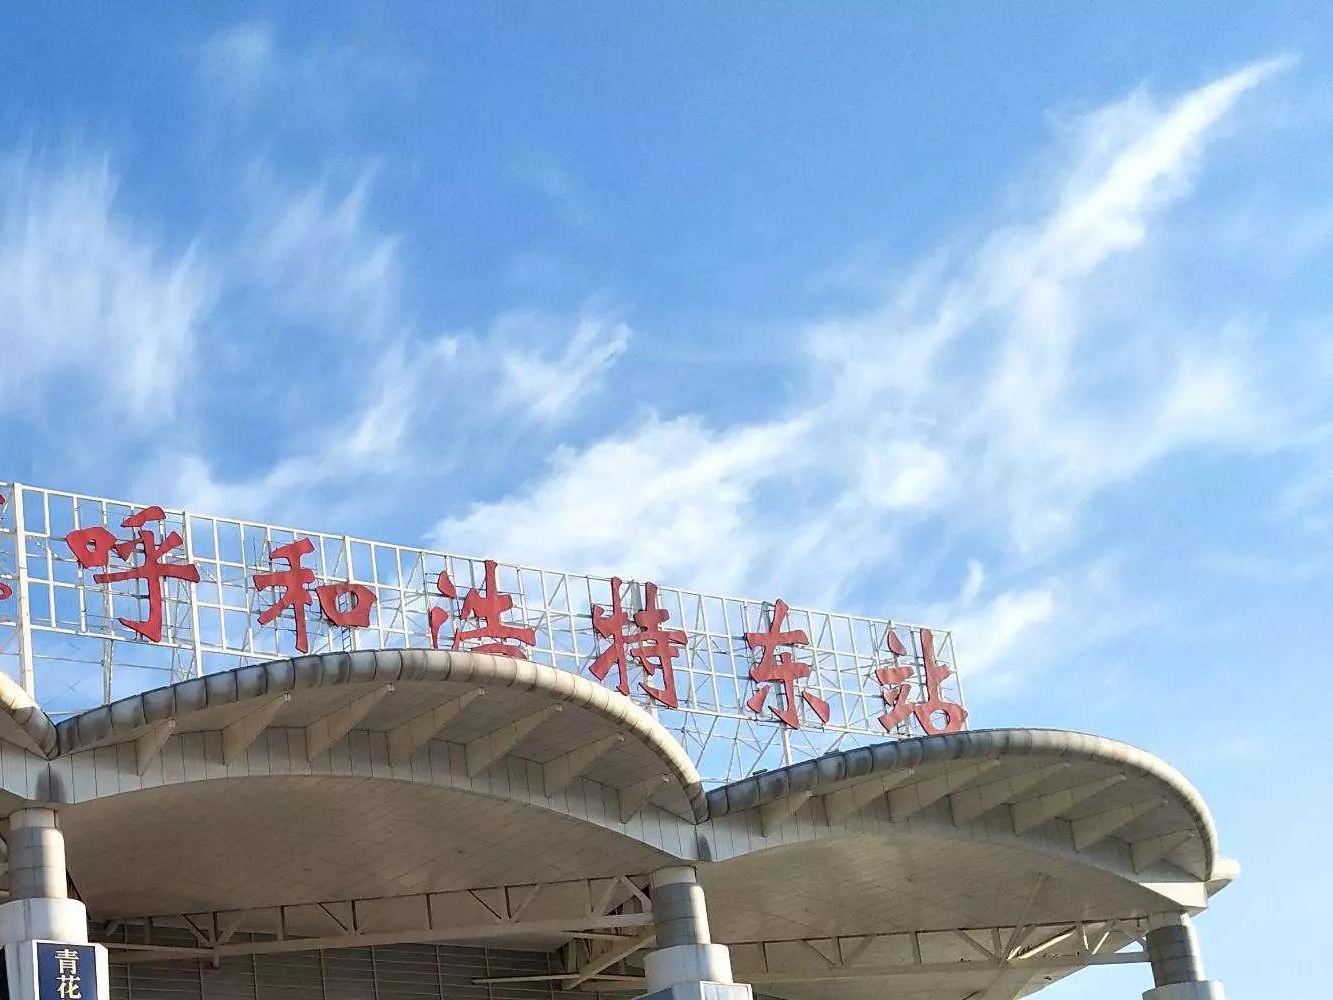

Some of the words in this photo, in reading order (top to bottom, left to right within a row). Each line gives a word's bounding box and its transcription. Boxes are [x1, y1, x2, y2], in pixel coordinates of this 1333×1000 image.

[66, 505, 968, 736] 呼和浩特东站
